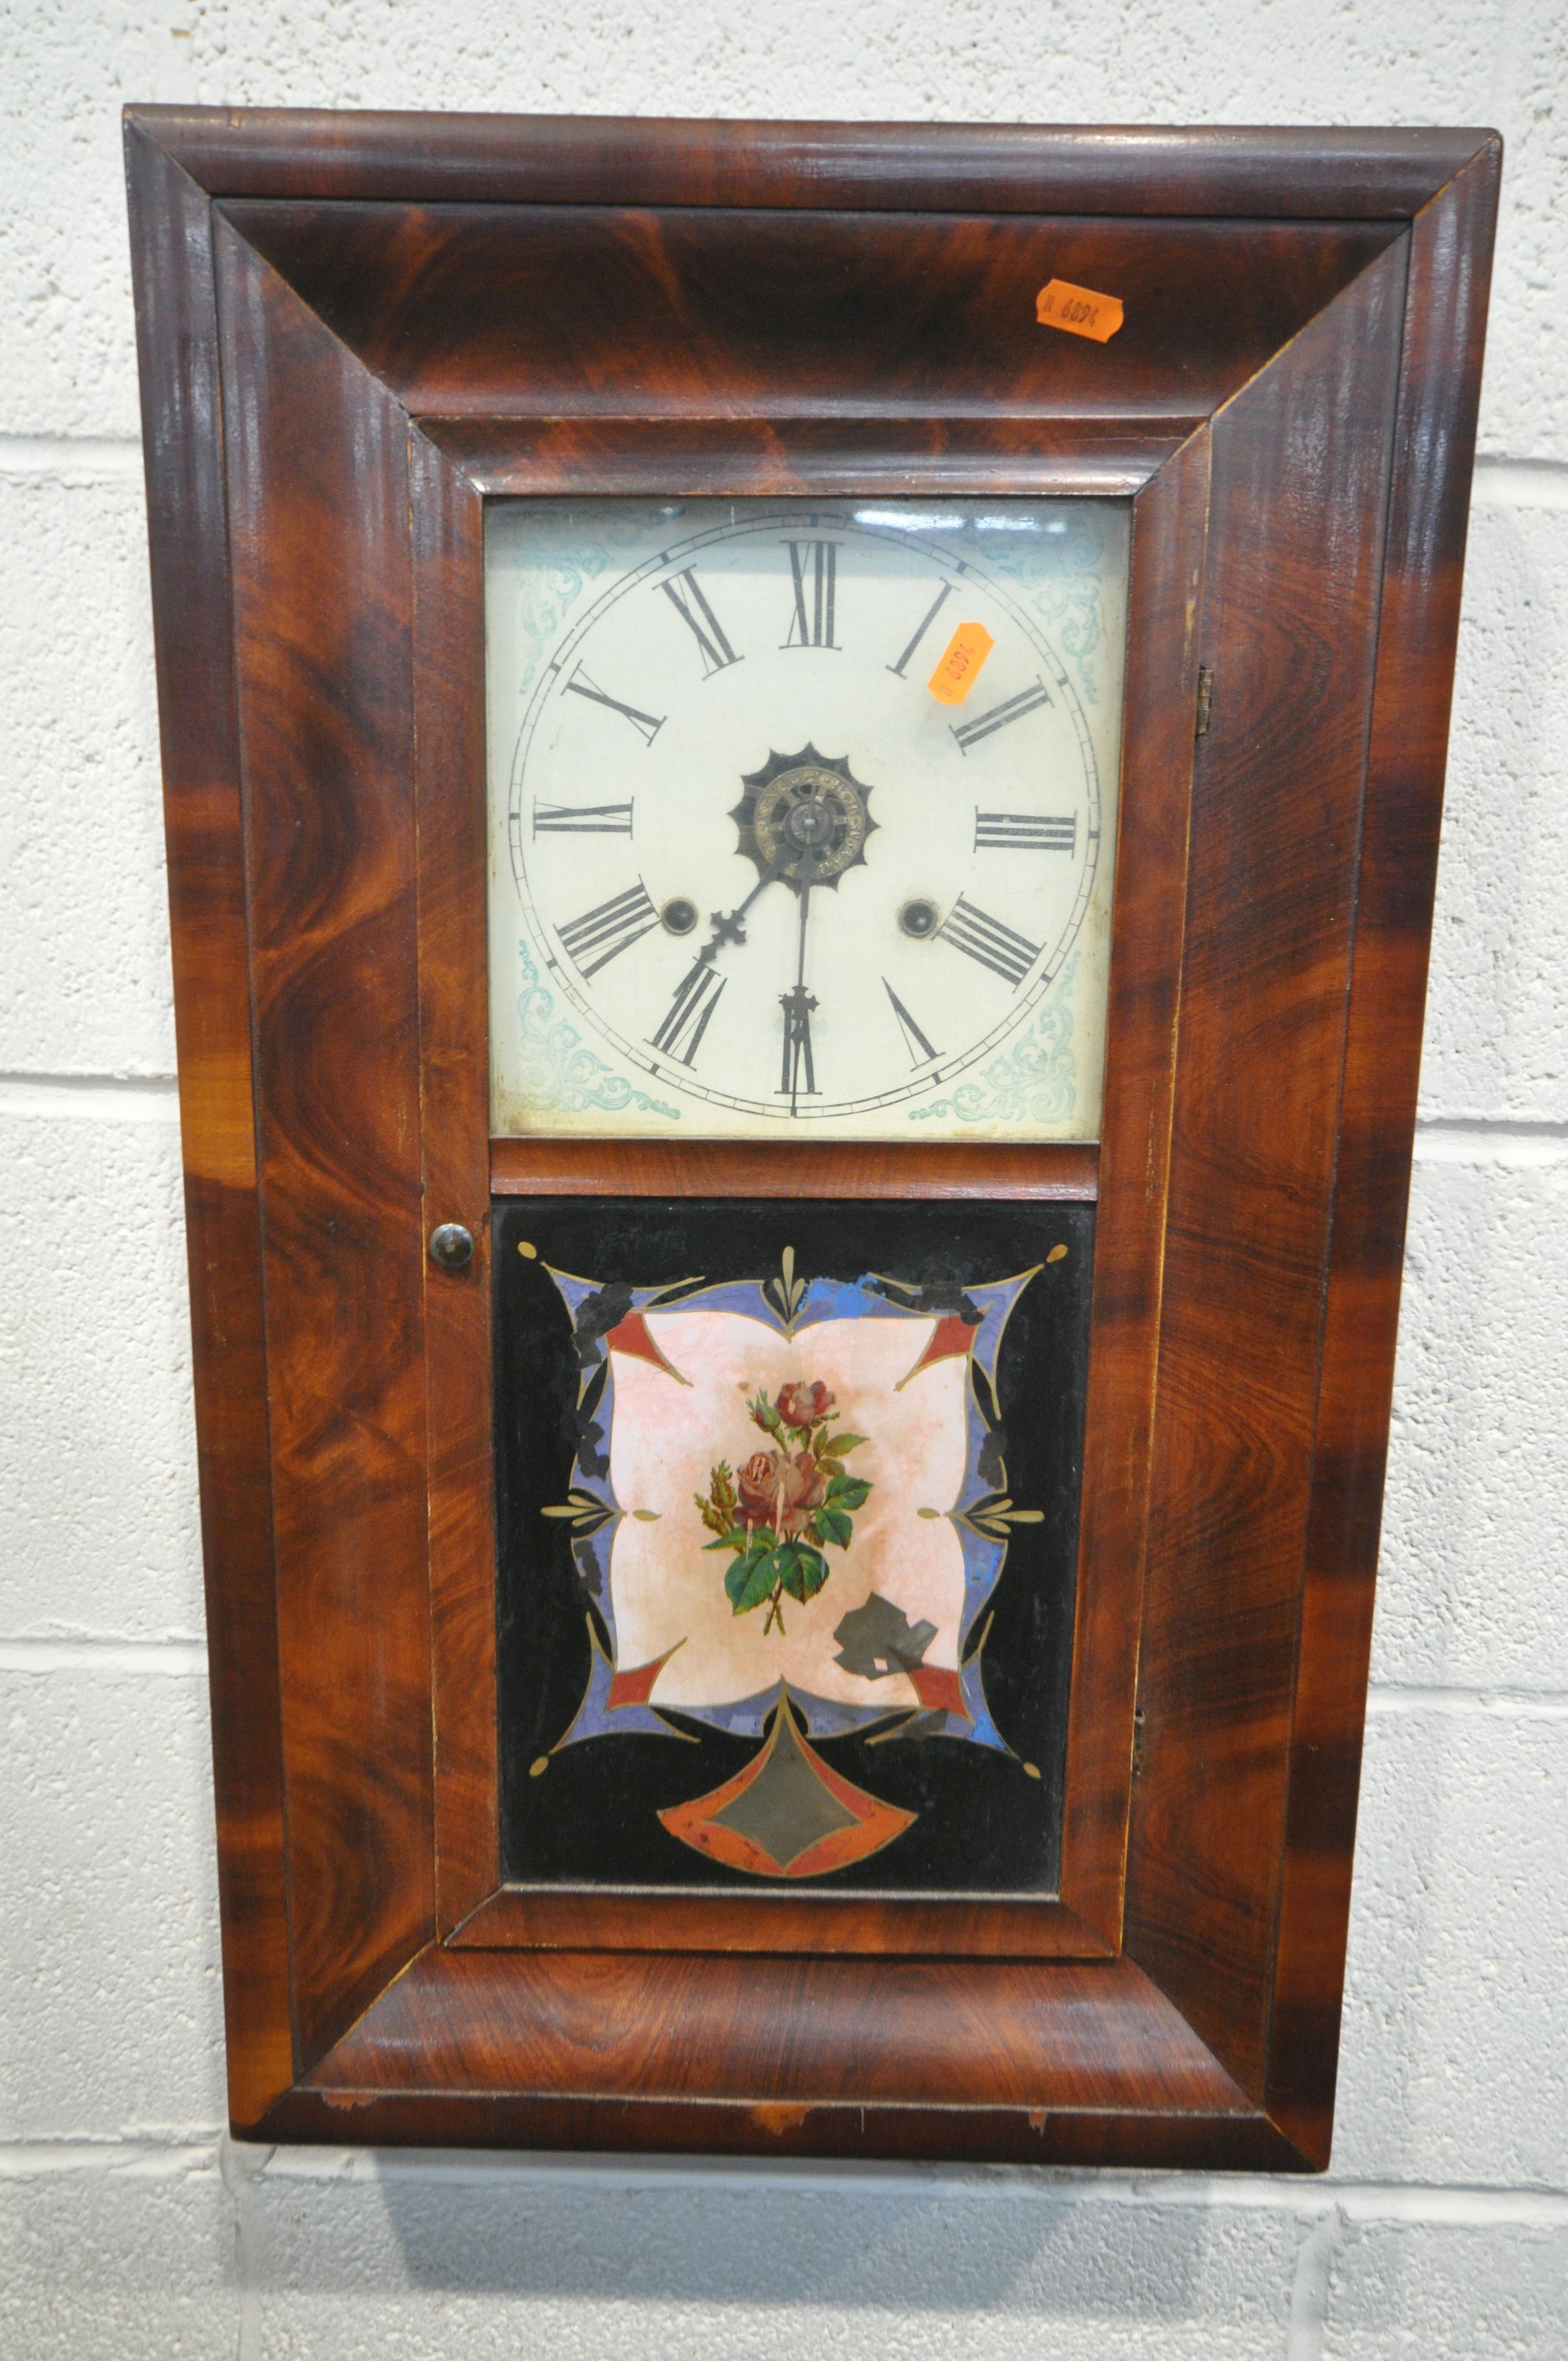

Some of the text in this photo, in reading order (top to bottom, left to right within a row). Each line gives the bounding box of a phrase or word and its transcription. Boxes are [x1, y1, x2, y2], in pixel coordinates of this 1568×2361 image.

[1061, 298, 1100, 327] 6894
[652, 564, 745, 681] XI
[779, 540, 843, 650] XII
[886, 577, 961, 679] I
[560, 659, 668, 747] X
[949, 675, 1054, 757] II
[532, 795, 635, 841] IX
[974, 805, 1077, 859] III
[553, 874, 661, 988] VIII
[932, 891, 1047, 994] IIII
[643, 957, 727, 1071] VII
[882, 976, 946, 1072] V
